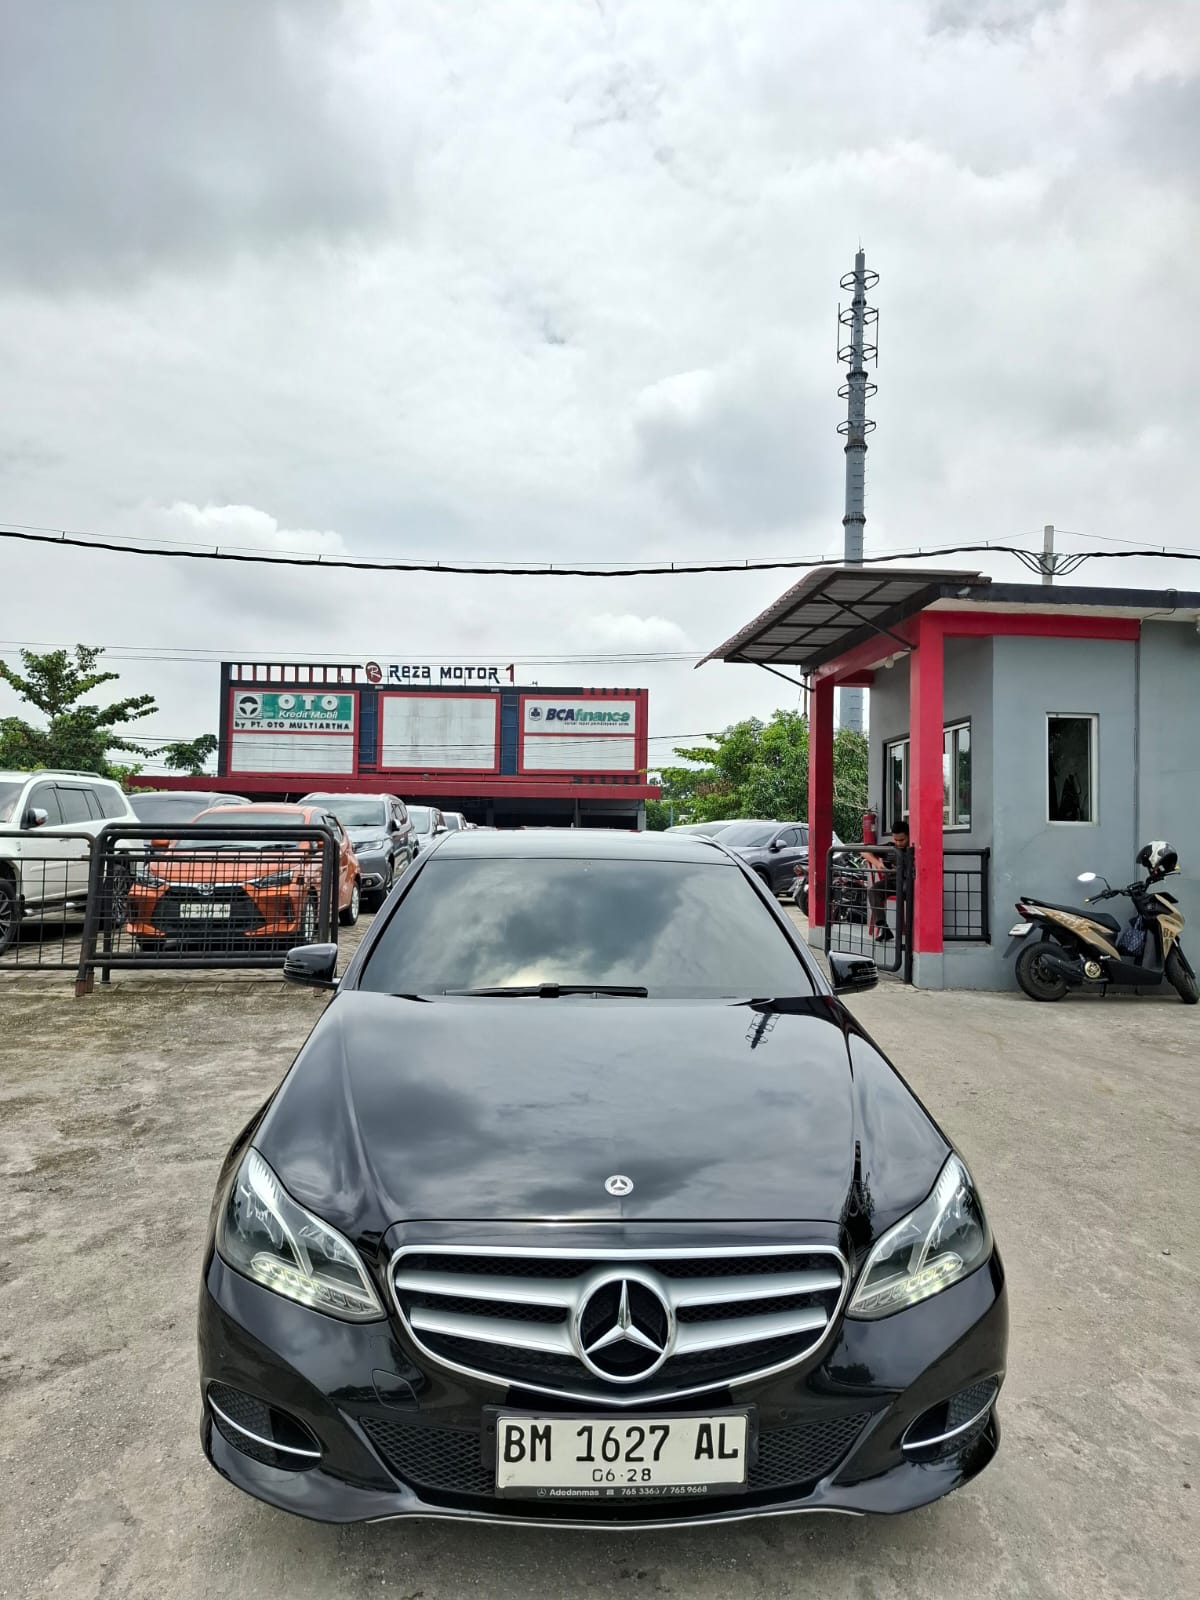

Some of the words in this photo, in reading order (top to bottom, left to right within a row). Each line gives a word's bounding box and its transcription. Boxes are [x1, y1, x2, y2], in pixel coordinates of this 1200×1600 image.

[440, 666, 500, 684] MOTOR
[505, 664, 515, 682] 1
[278, 694, 338, 711] OTO
[278, 710, 307, 718] Kredit
[310, 711, 338, 719] Mobil
[234, 721, 246, 729] by
[267, 721, 285, 729] OTO
[289, 722, 350, 730] MULTIARTHA
[503, 1424, 552, 1462] BM
[576, 1424, 670, 1463] 1627
[694, 1423, 739, 1460] AL
[621, 1487, 637, 1496] 765
[670, 1486, 685, 1494] 765
